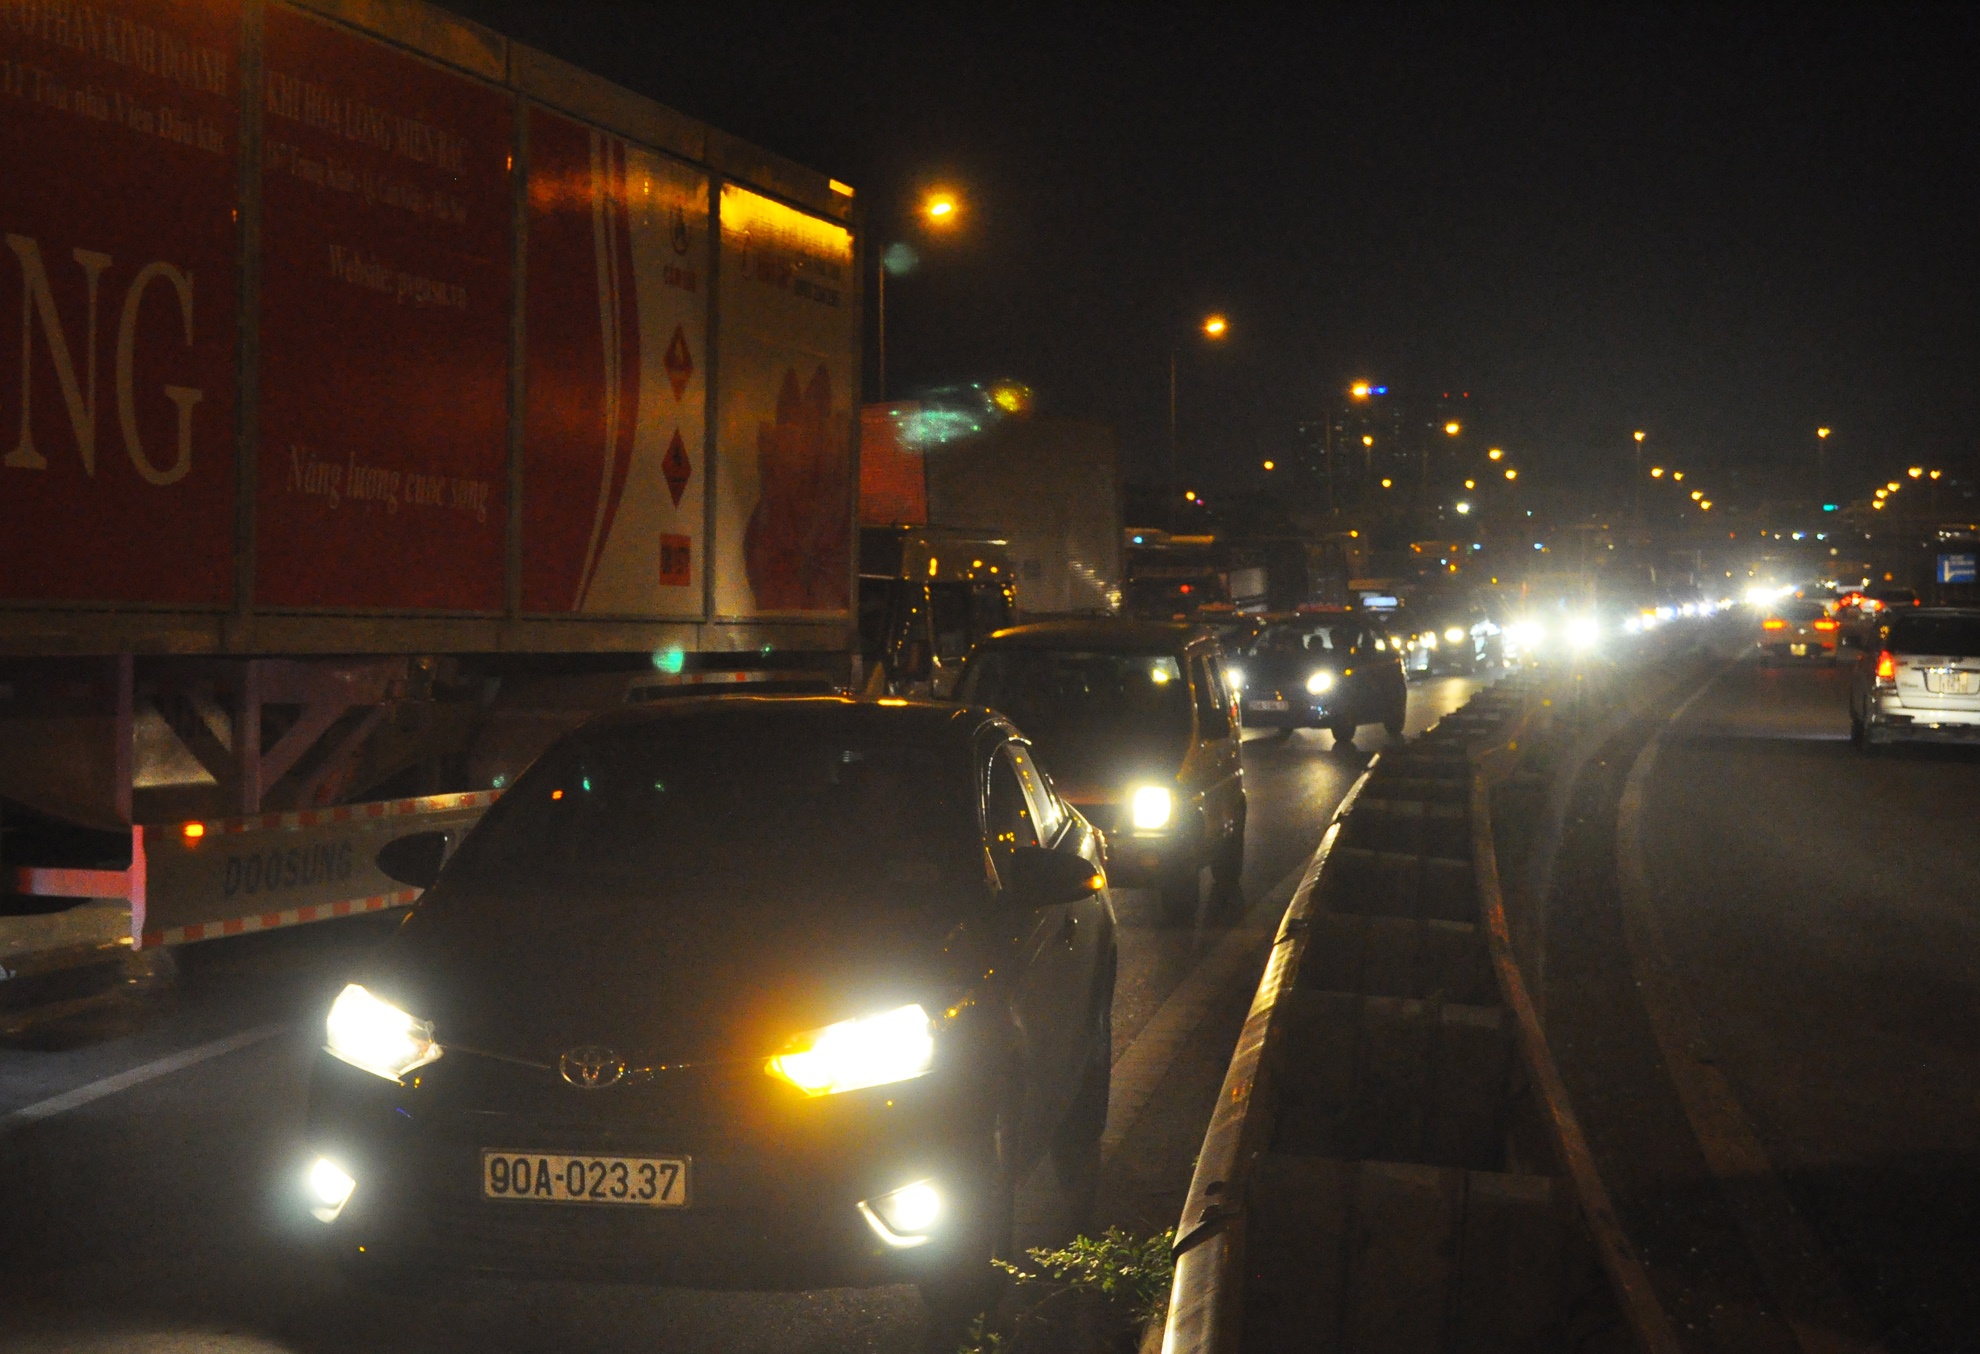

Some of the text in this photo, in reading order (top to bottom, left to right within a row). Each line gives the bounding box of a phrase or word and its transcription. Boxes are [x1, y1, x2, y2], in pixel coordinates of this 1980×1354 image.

[5, 233, 202, 485] NG
[224, 840, 353, 897] DOOSUNG
[491, 1157, 679, 1200] 90A-023.37
